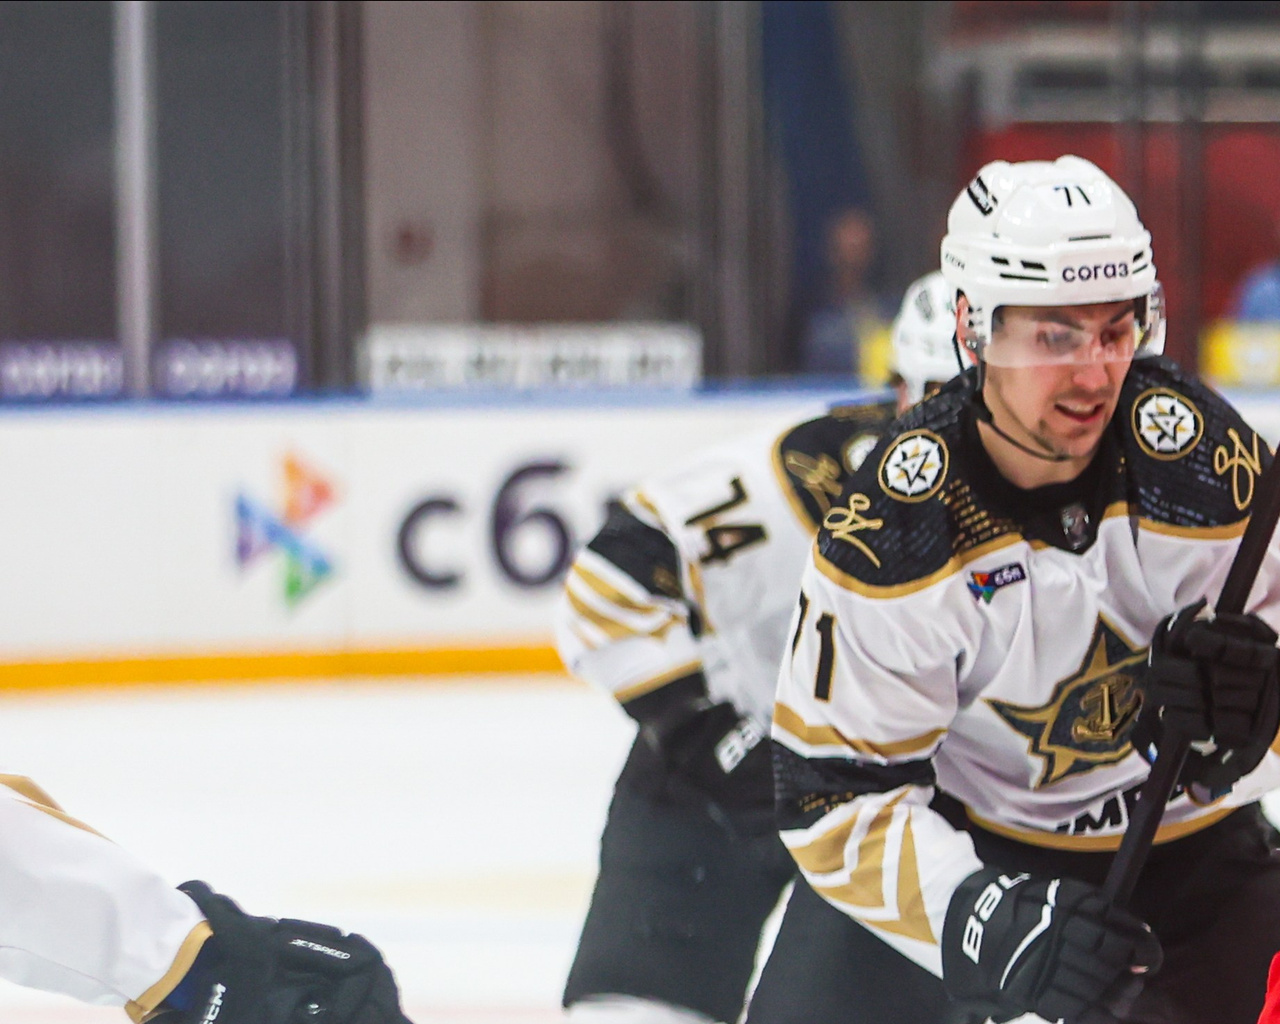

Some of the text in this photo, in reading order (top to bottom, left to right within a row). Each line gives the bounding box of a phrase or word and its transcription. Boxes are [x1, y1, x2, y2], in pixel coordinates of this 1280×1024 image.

[1054, 185, 1092, 207] 71
[1062, 263, 1129, 284] согаз
[396, 460, 620, 590] сб
[289, 938, 351, 960] JETSPEED
